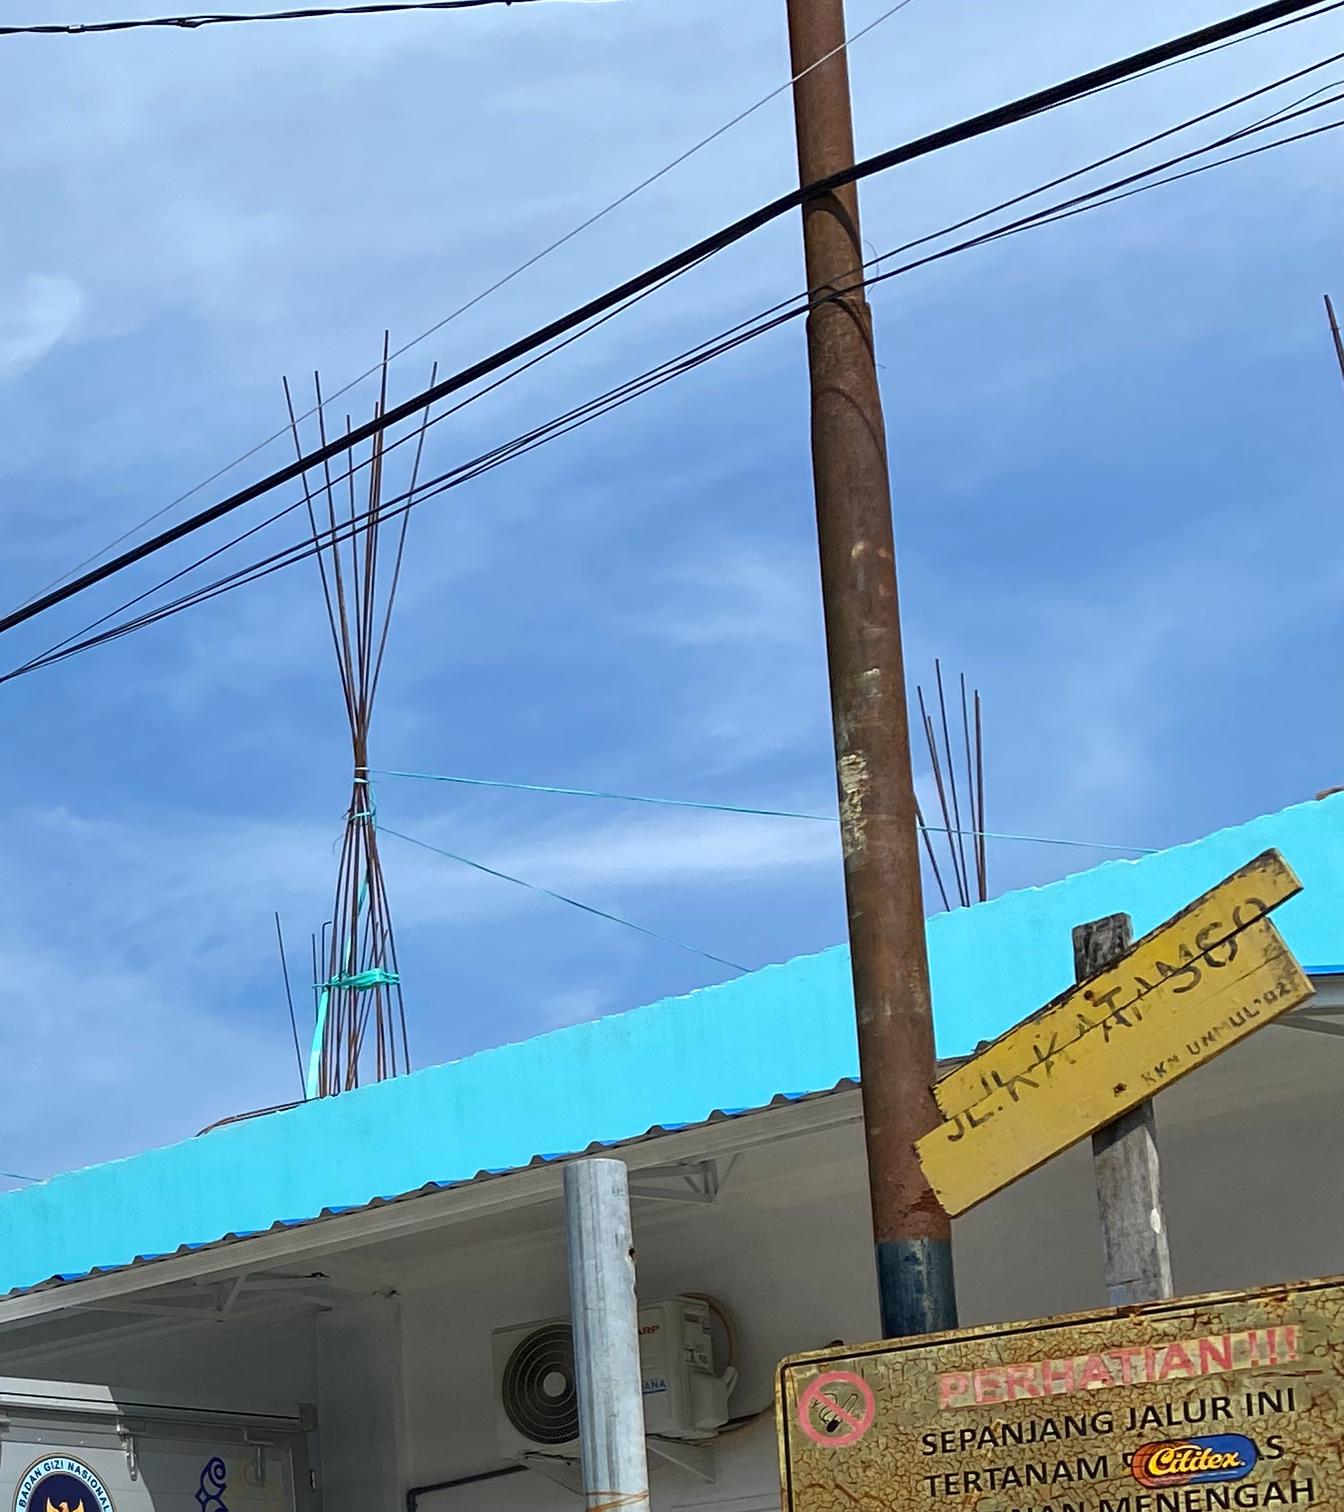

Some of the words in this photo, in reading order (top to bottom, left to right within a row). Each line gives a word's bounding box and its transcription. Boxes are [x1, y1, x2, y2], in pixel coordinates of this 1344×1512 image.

[938, 1337, 1233, 1408] PERHATIAN
[923, 1411, 1113, 1456] SEPANJANG
[1125, 1396, 1233, 1432] JALUR
[1246, 1387, 1296, 1417] INI
[18, 1469, 43, 1508] BADAN
[43, 1460, 64, 1472] GIZI
[68, 1462, 111, 1512] NASIONAL
[924, 1455, 1109, 1498] TERTANAM
